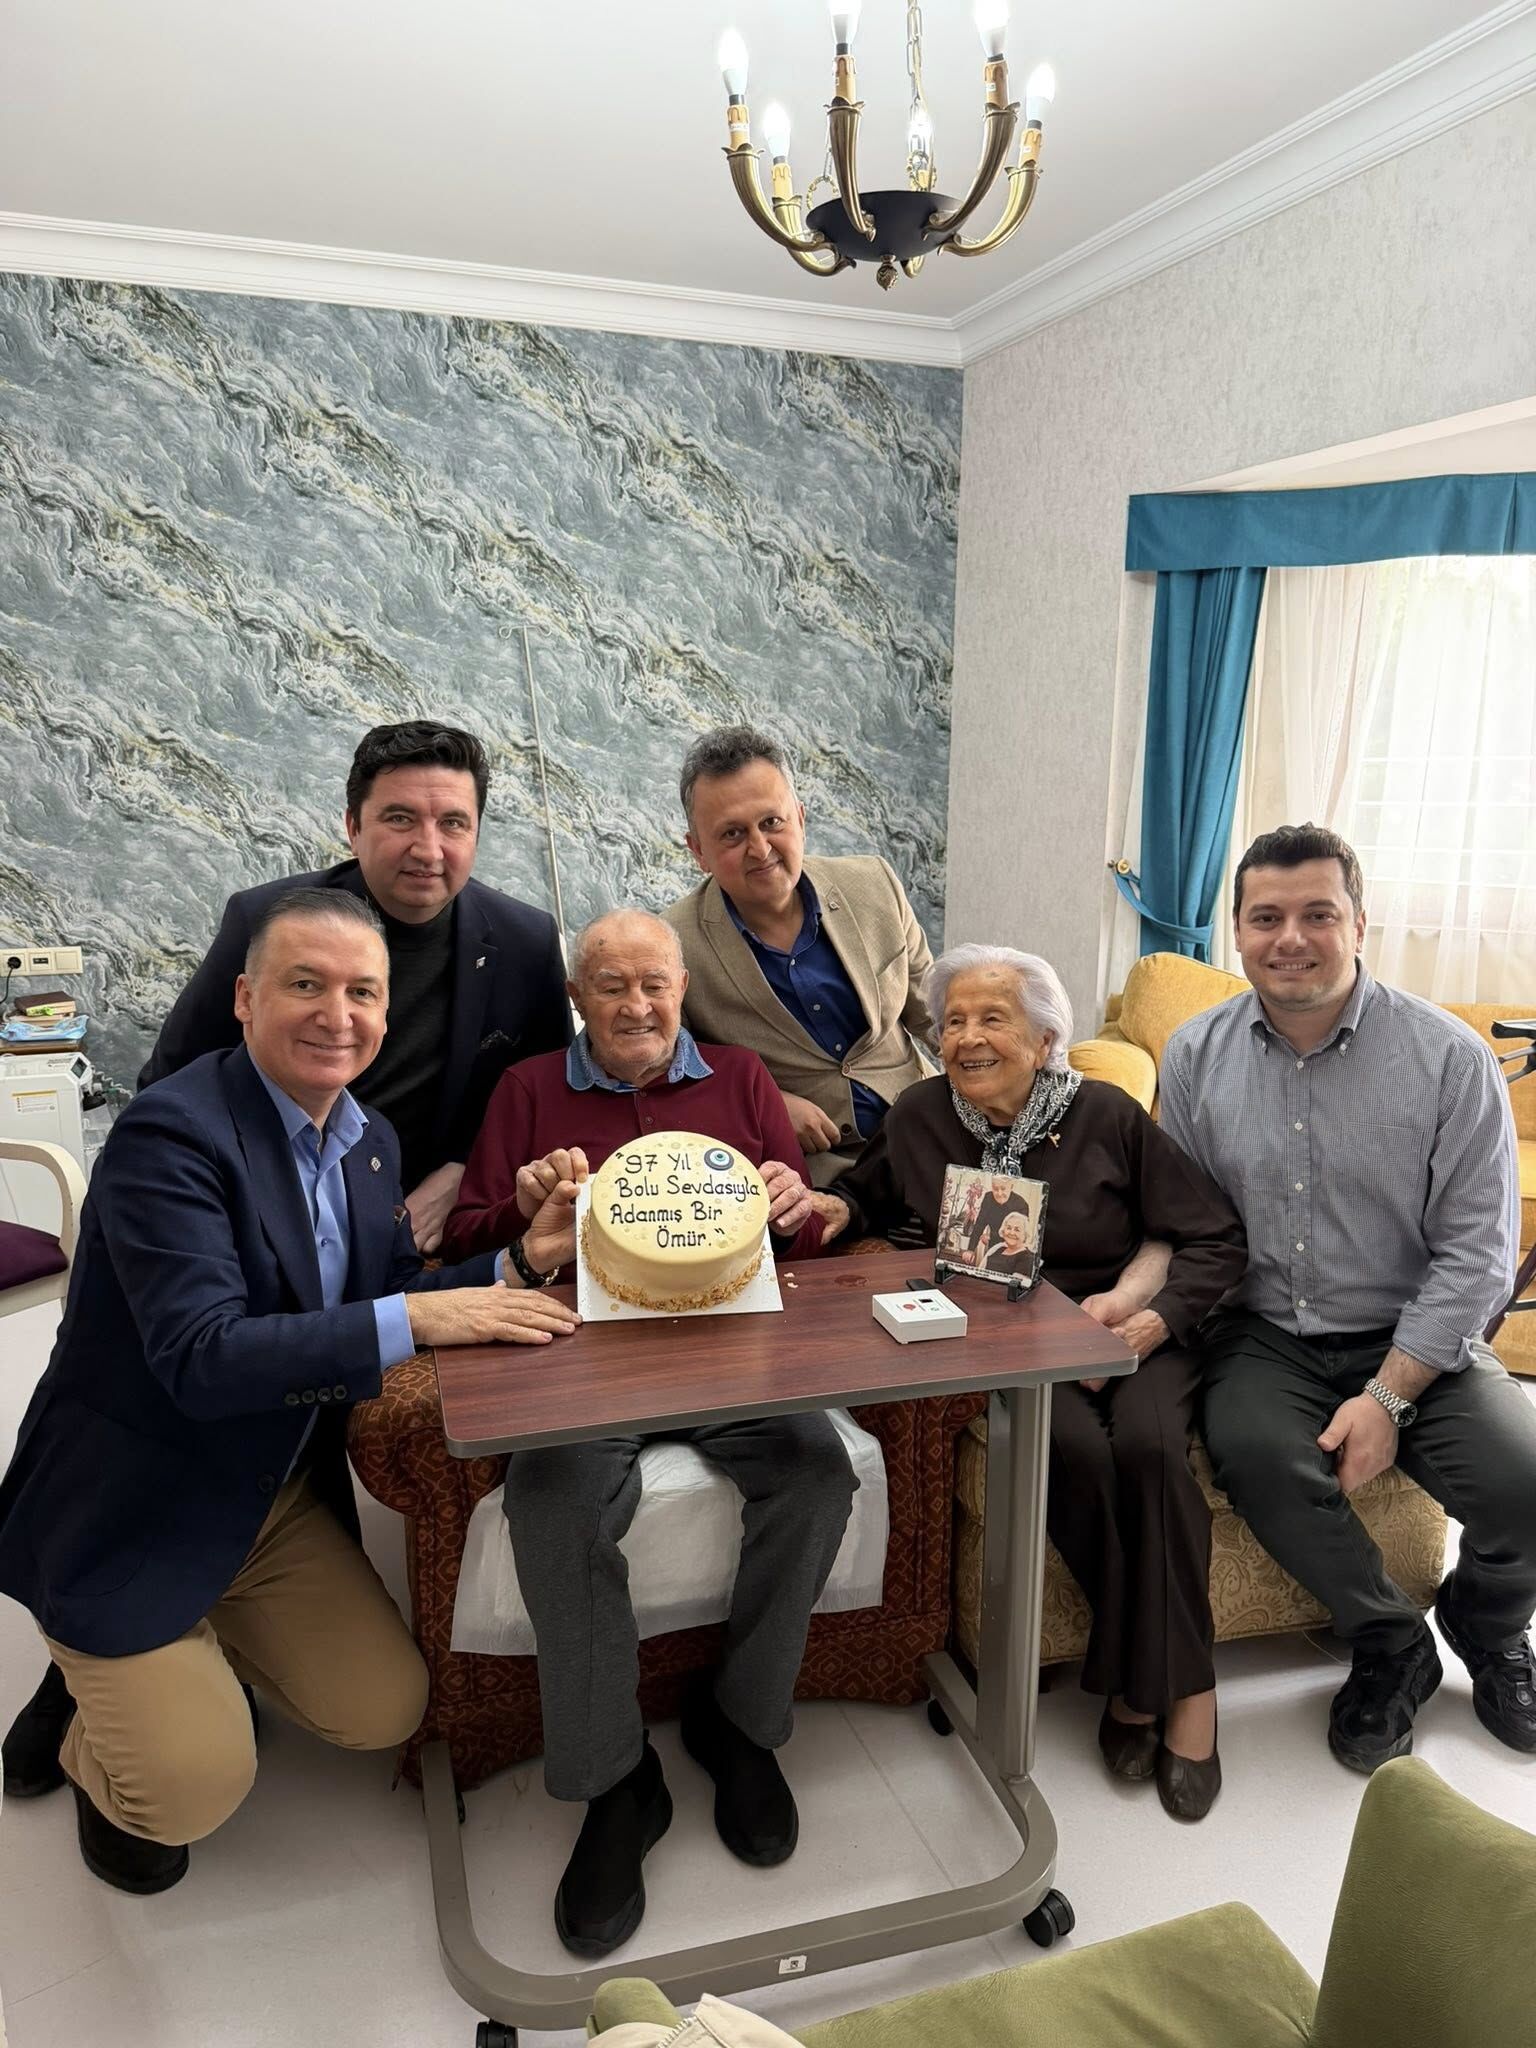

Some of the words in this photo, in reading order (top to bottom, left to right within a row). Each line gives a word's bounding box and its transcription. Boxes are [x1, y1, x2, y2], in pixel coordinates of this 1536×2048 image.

[667, 1153, 692, 1171] Yıl
[614, 1175, 659, 1198] Bolu
[666, 1174, 760, 1202] Sevdasıyla
[609, 1203, 683, 1224] Adanmış
[690, 1200, 723, 1221] Bir
